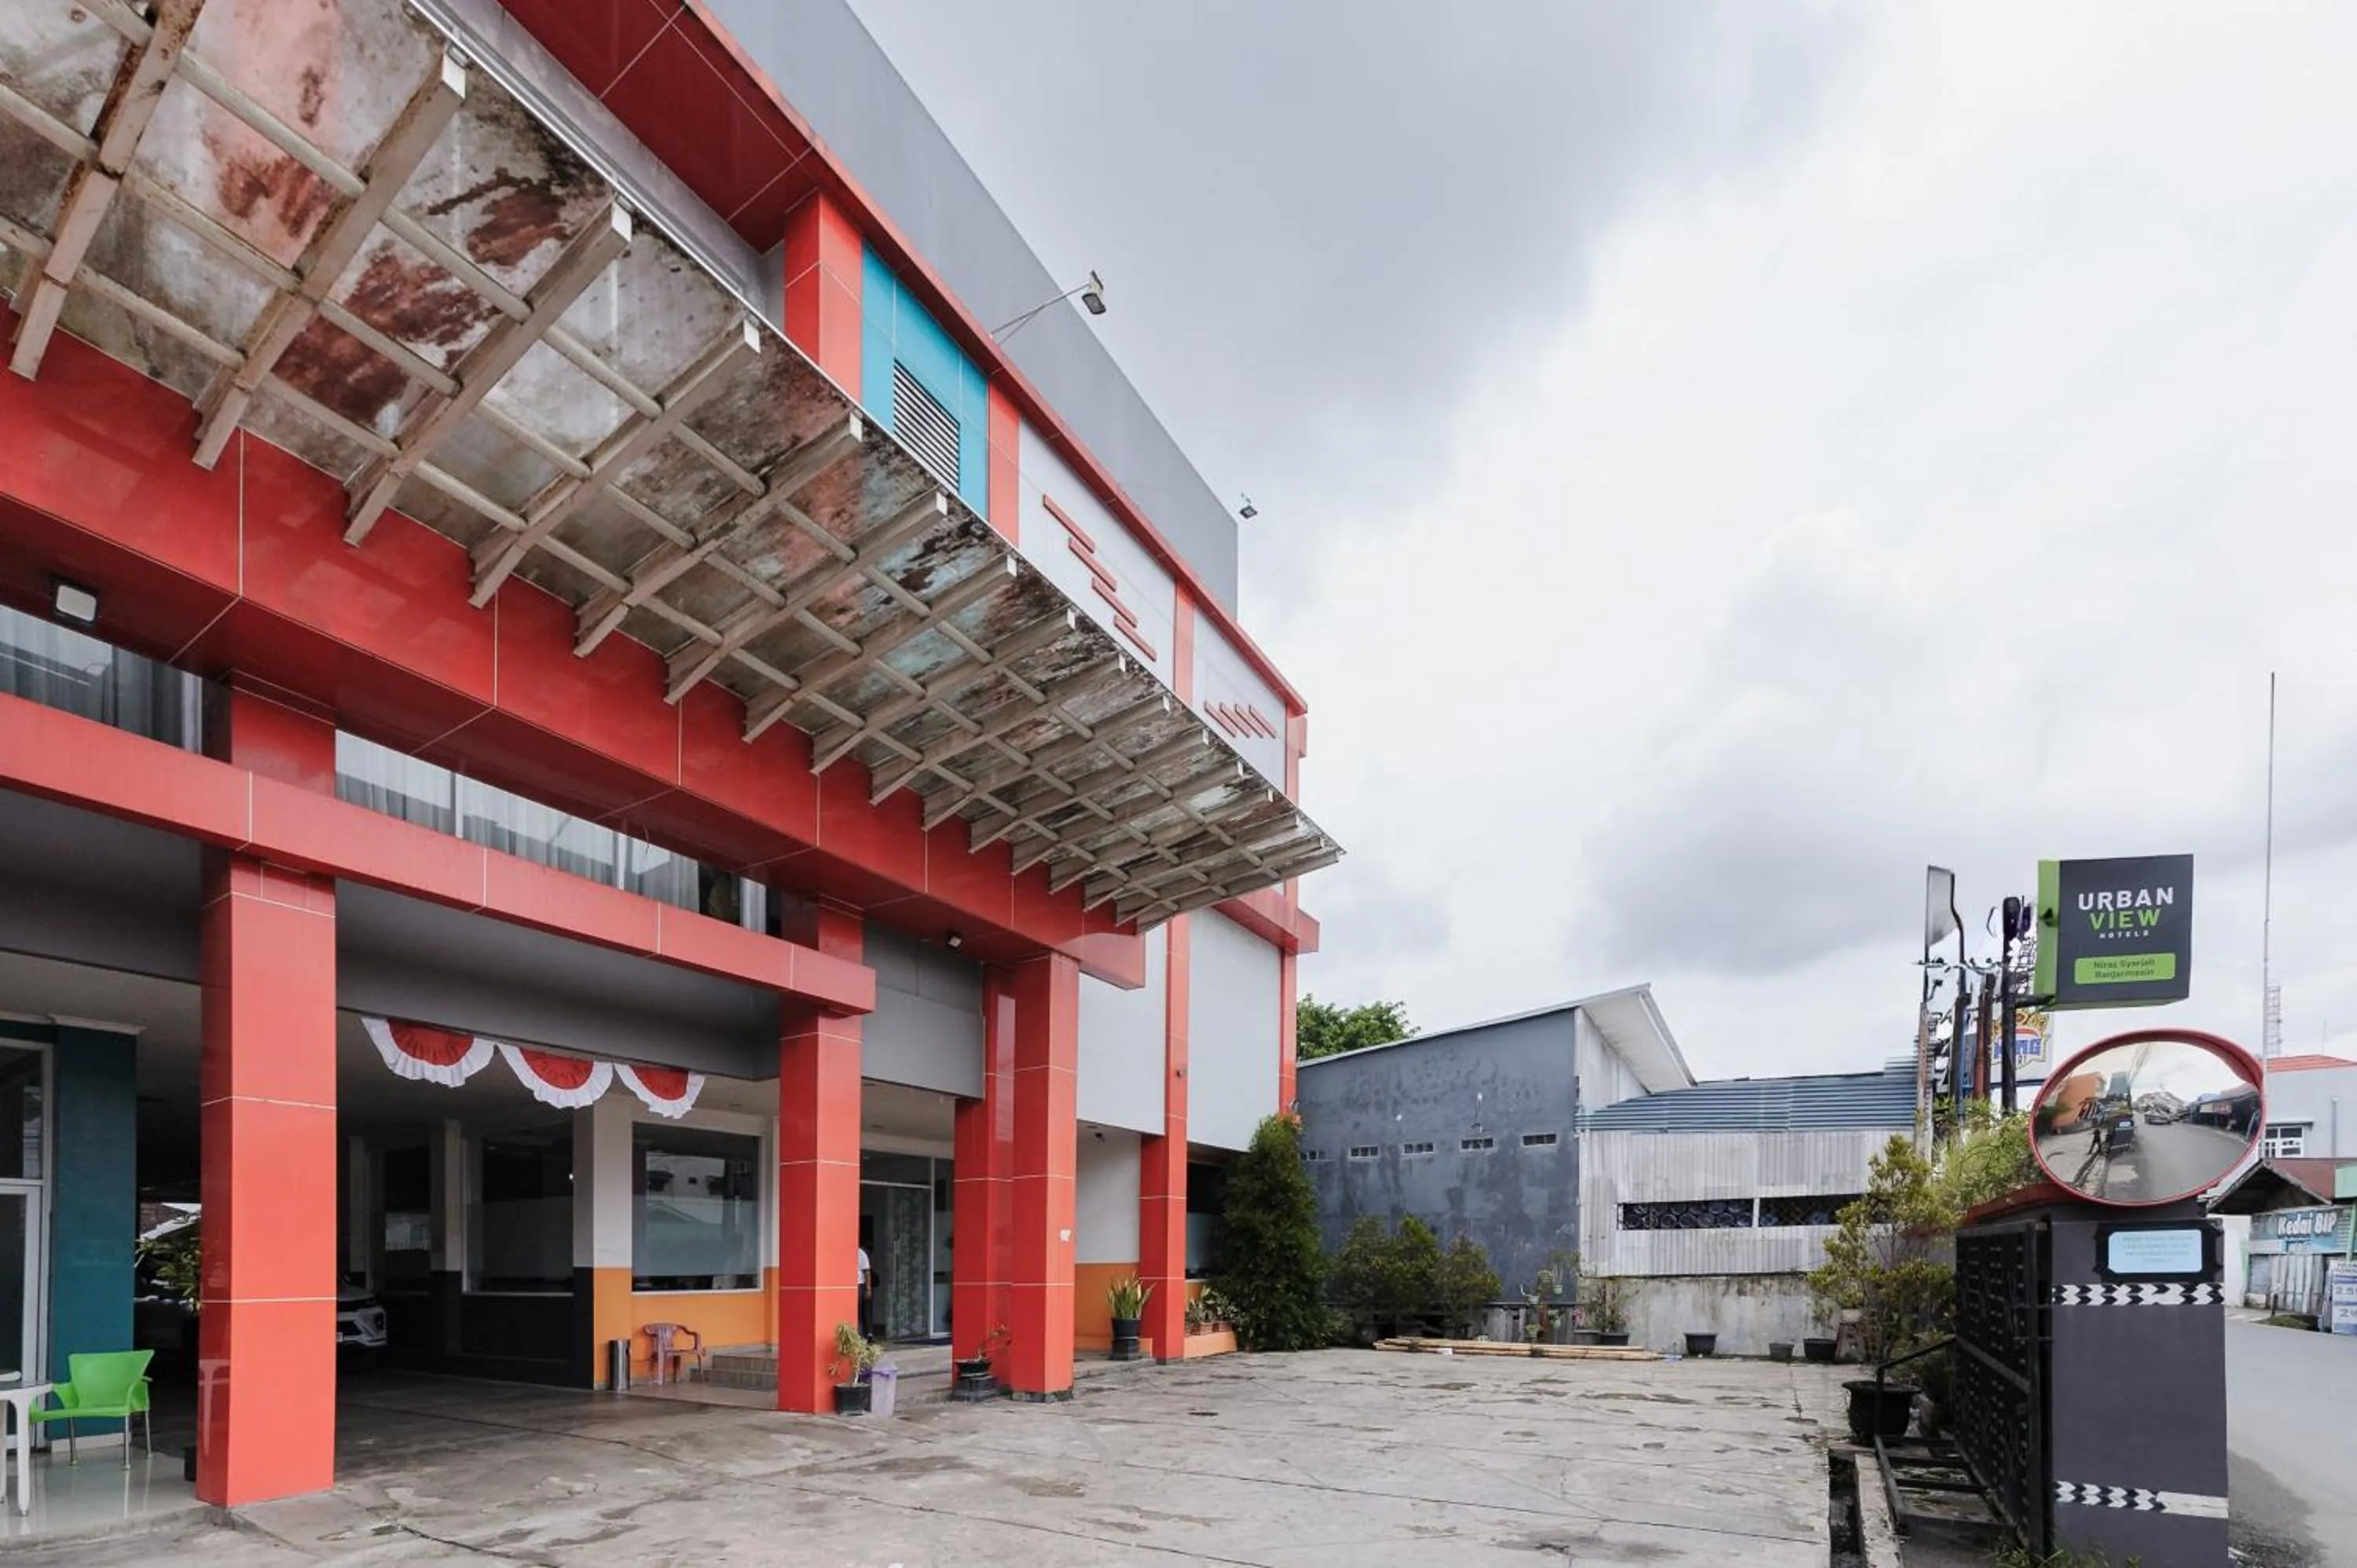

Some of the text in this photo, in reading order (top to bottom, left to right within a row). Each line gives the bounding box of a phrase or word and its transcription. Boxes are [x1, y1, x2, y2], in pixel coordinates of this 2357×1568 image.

[2078, 887, 2174, 911] URBAN
[2090, 908, 2161, 930] VIEW
[2099, 929, 2149, 939] HOTELS
[2278, 1211, 2313, 1235] Kedai
